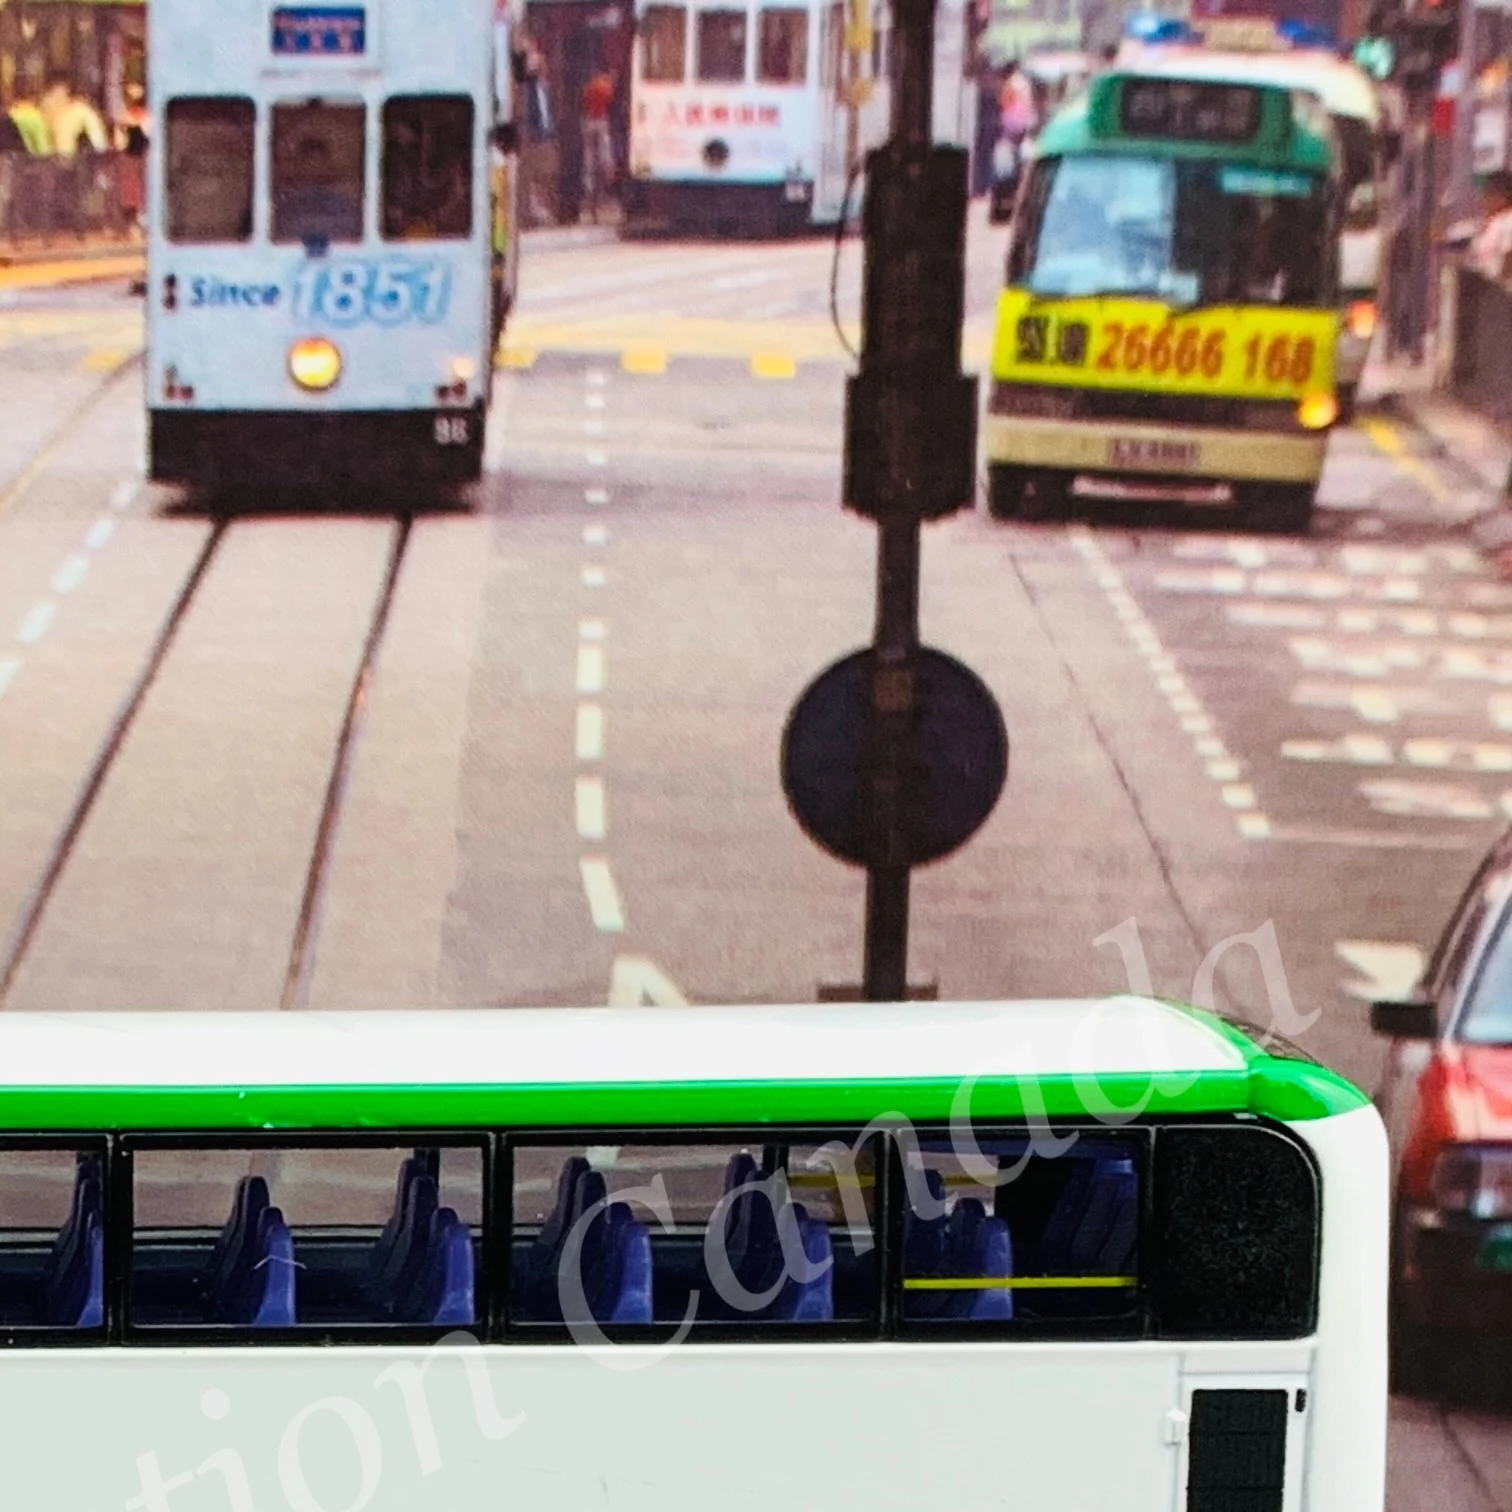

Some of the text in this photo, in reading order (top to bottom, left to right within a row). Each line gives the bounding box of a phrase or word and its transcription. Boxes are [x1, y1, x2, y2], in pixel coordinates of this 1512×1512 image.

[190, 258, 452, 328] Since 1851
[1095, 320, 1227, 379] 26666
